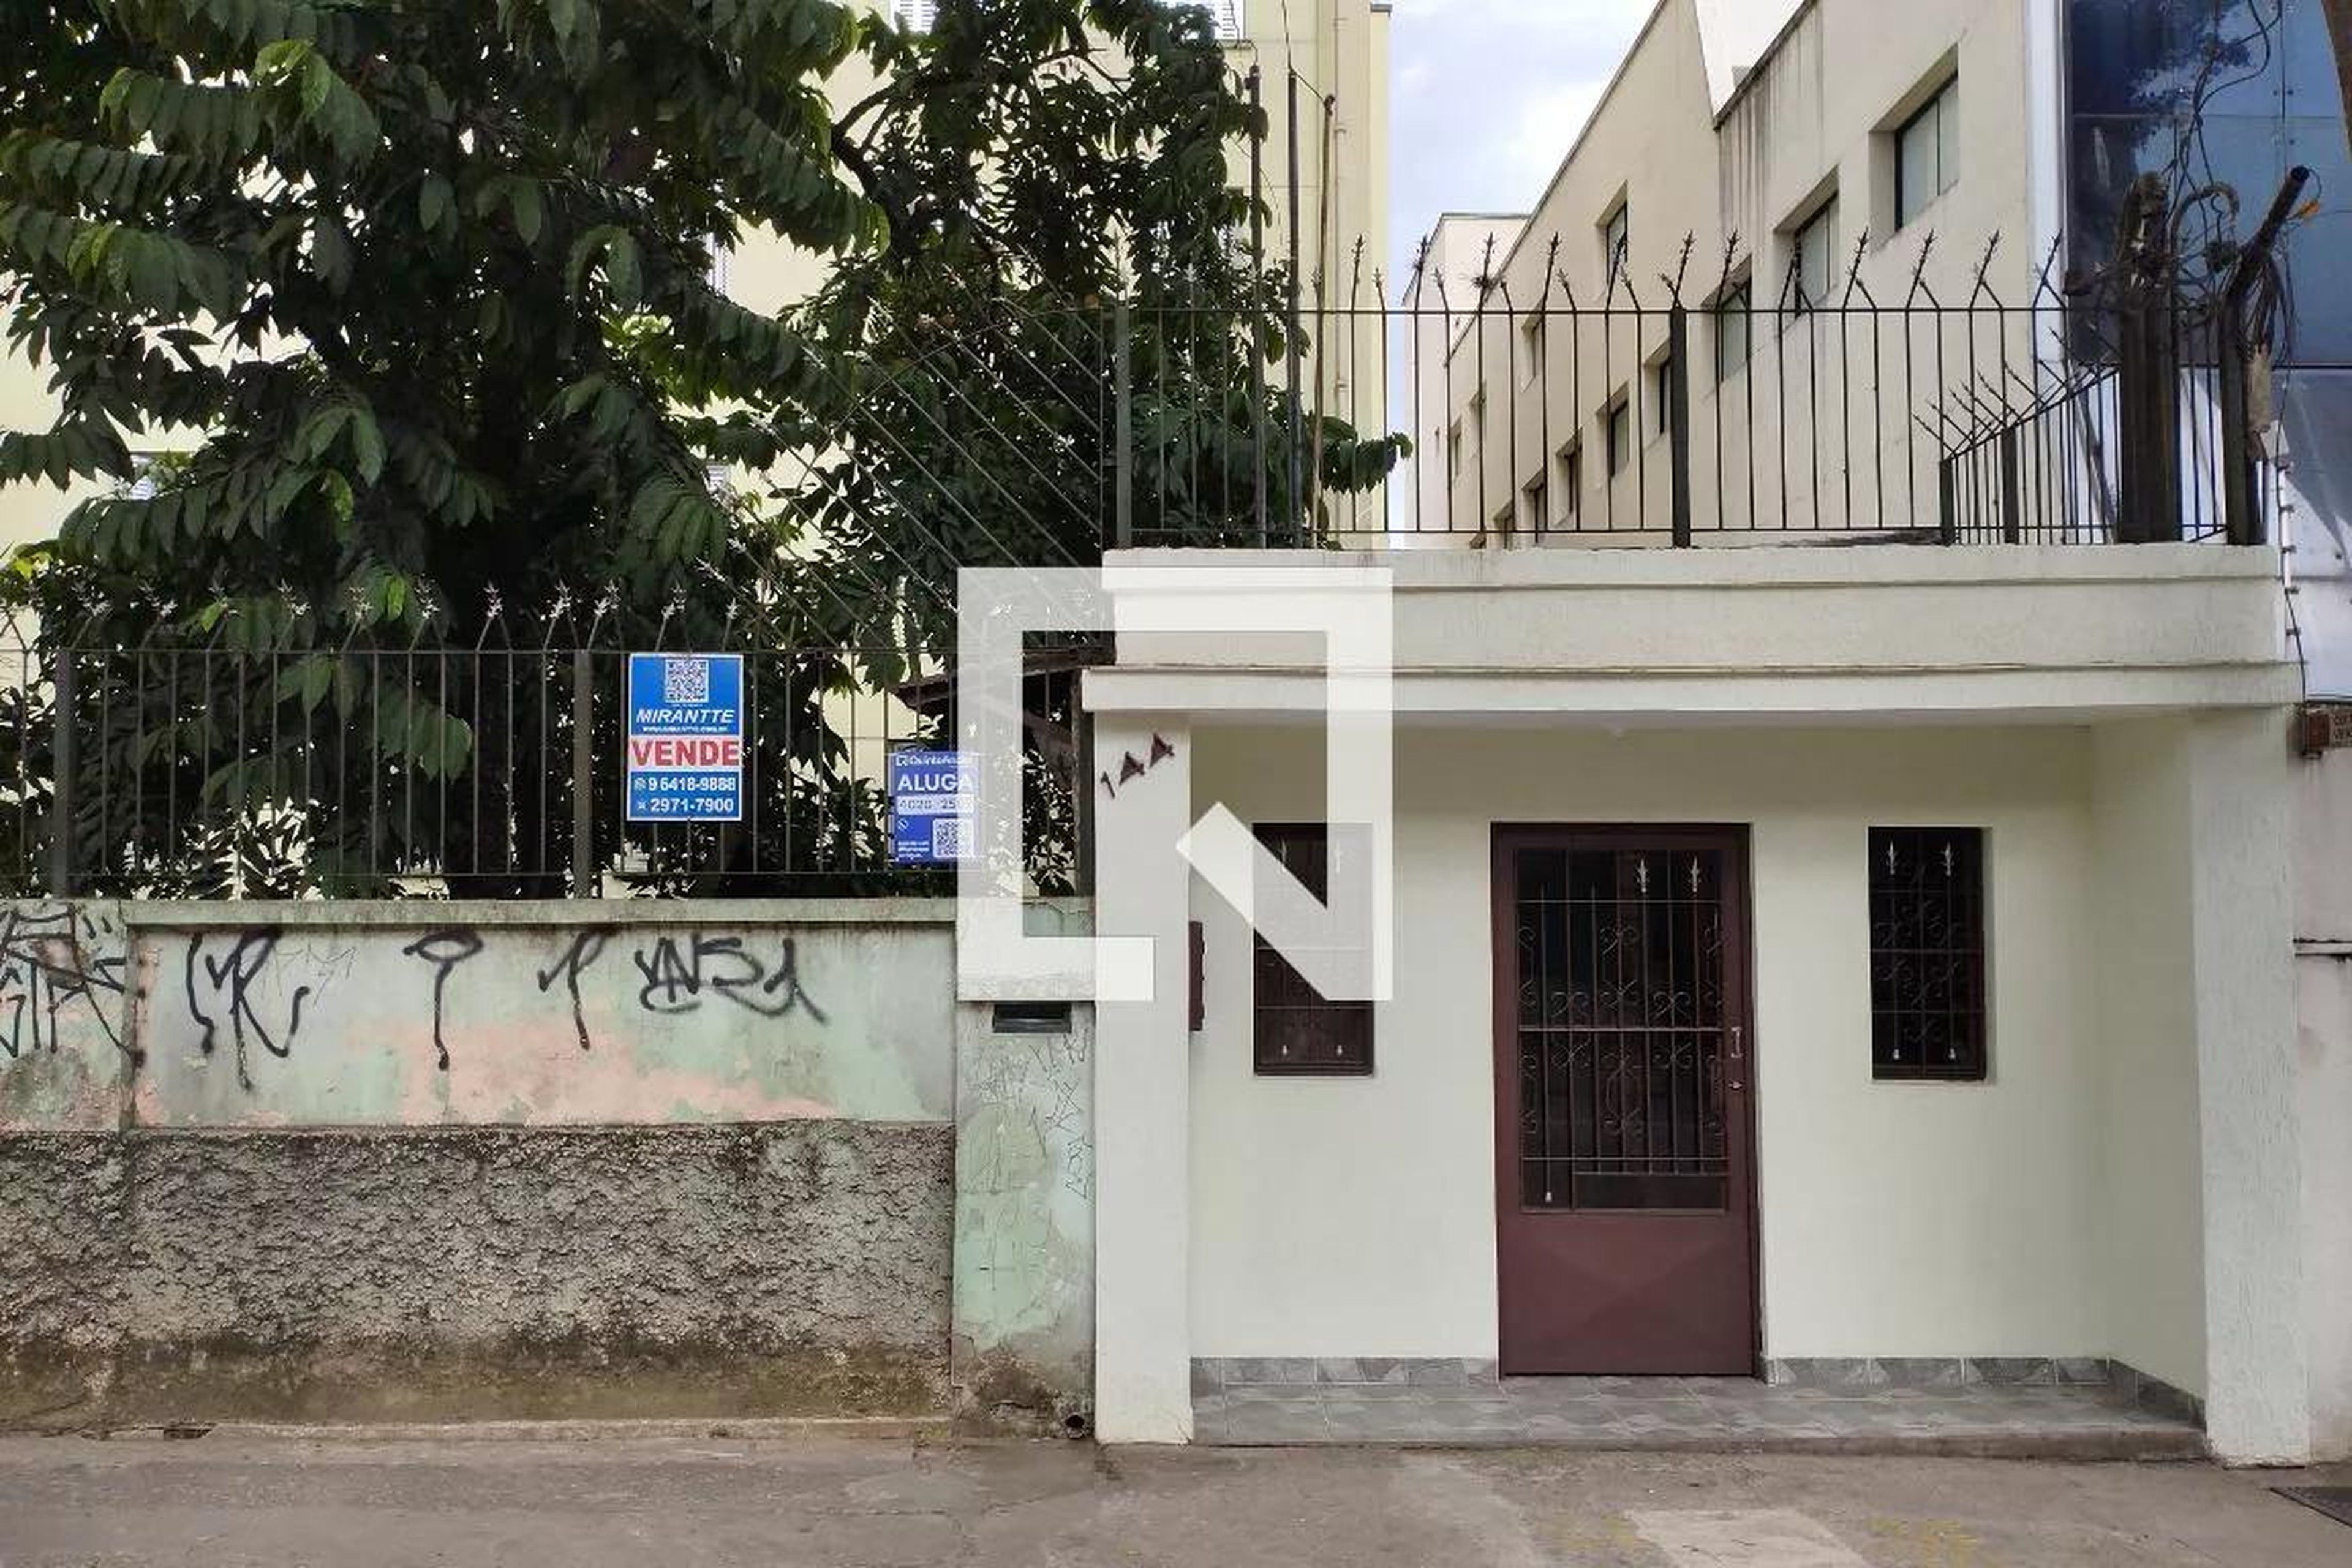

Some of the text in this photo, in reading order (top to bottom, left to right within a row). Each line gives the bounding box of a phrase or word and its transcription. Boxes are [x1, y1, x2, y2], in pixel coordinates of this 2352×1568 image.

[636, 709, 735, 723] MIRANTTE
[630, 740, 739, 766] VENDE
[897, 773, 973, 791] ALUGA
